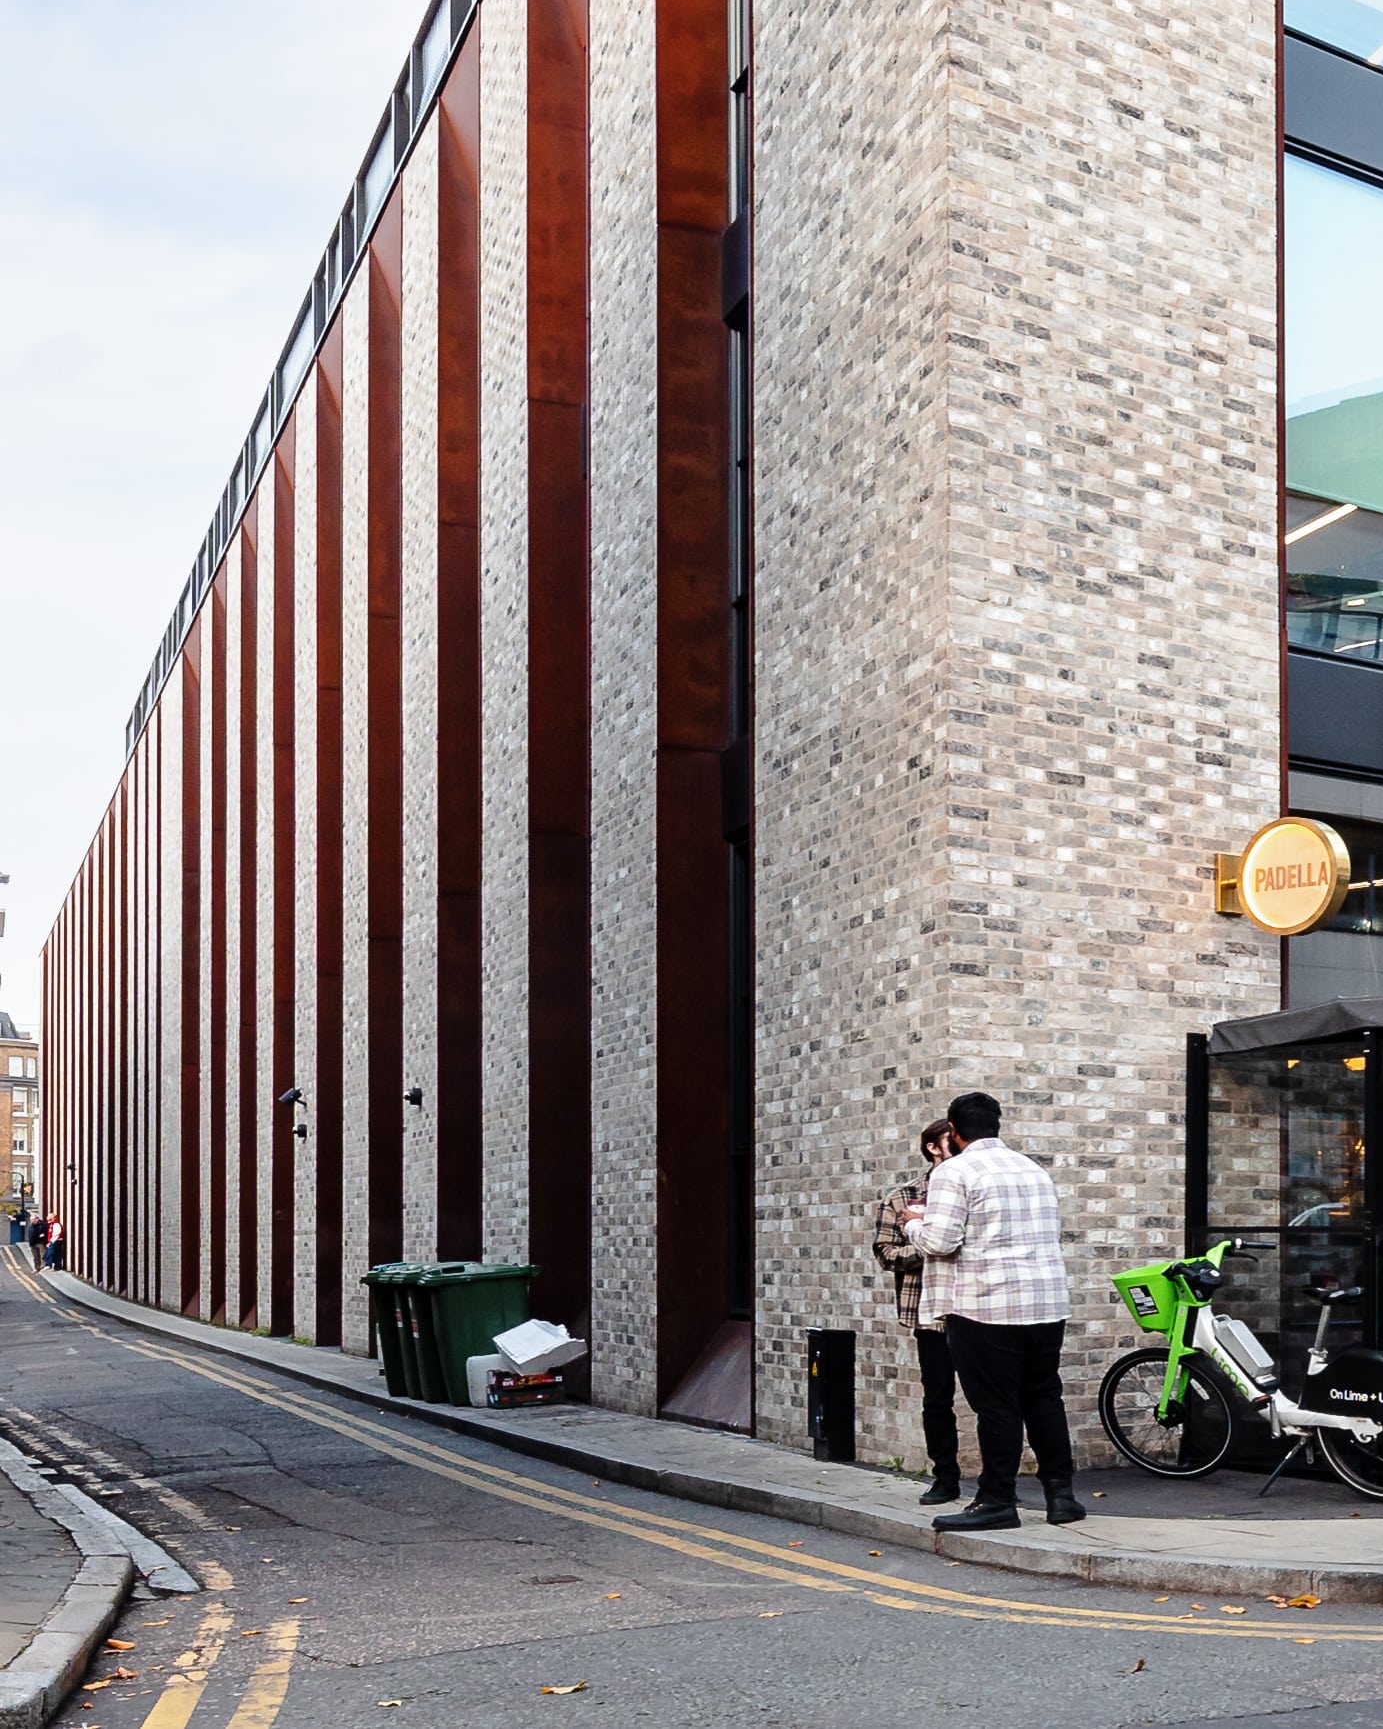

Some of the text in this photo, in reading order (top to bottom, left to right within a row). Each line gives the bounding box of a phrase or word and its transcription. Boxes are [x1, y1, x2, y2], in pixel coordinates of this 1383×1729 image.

[1255, 861, 1329, 892] PADELLA
[1329, 1388, 1344, 1400] On
[1344, 1389, 1369, 1402] Lime
